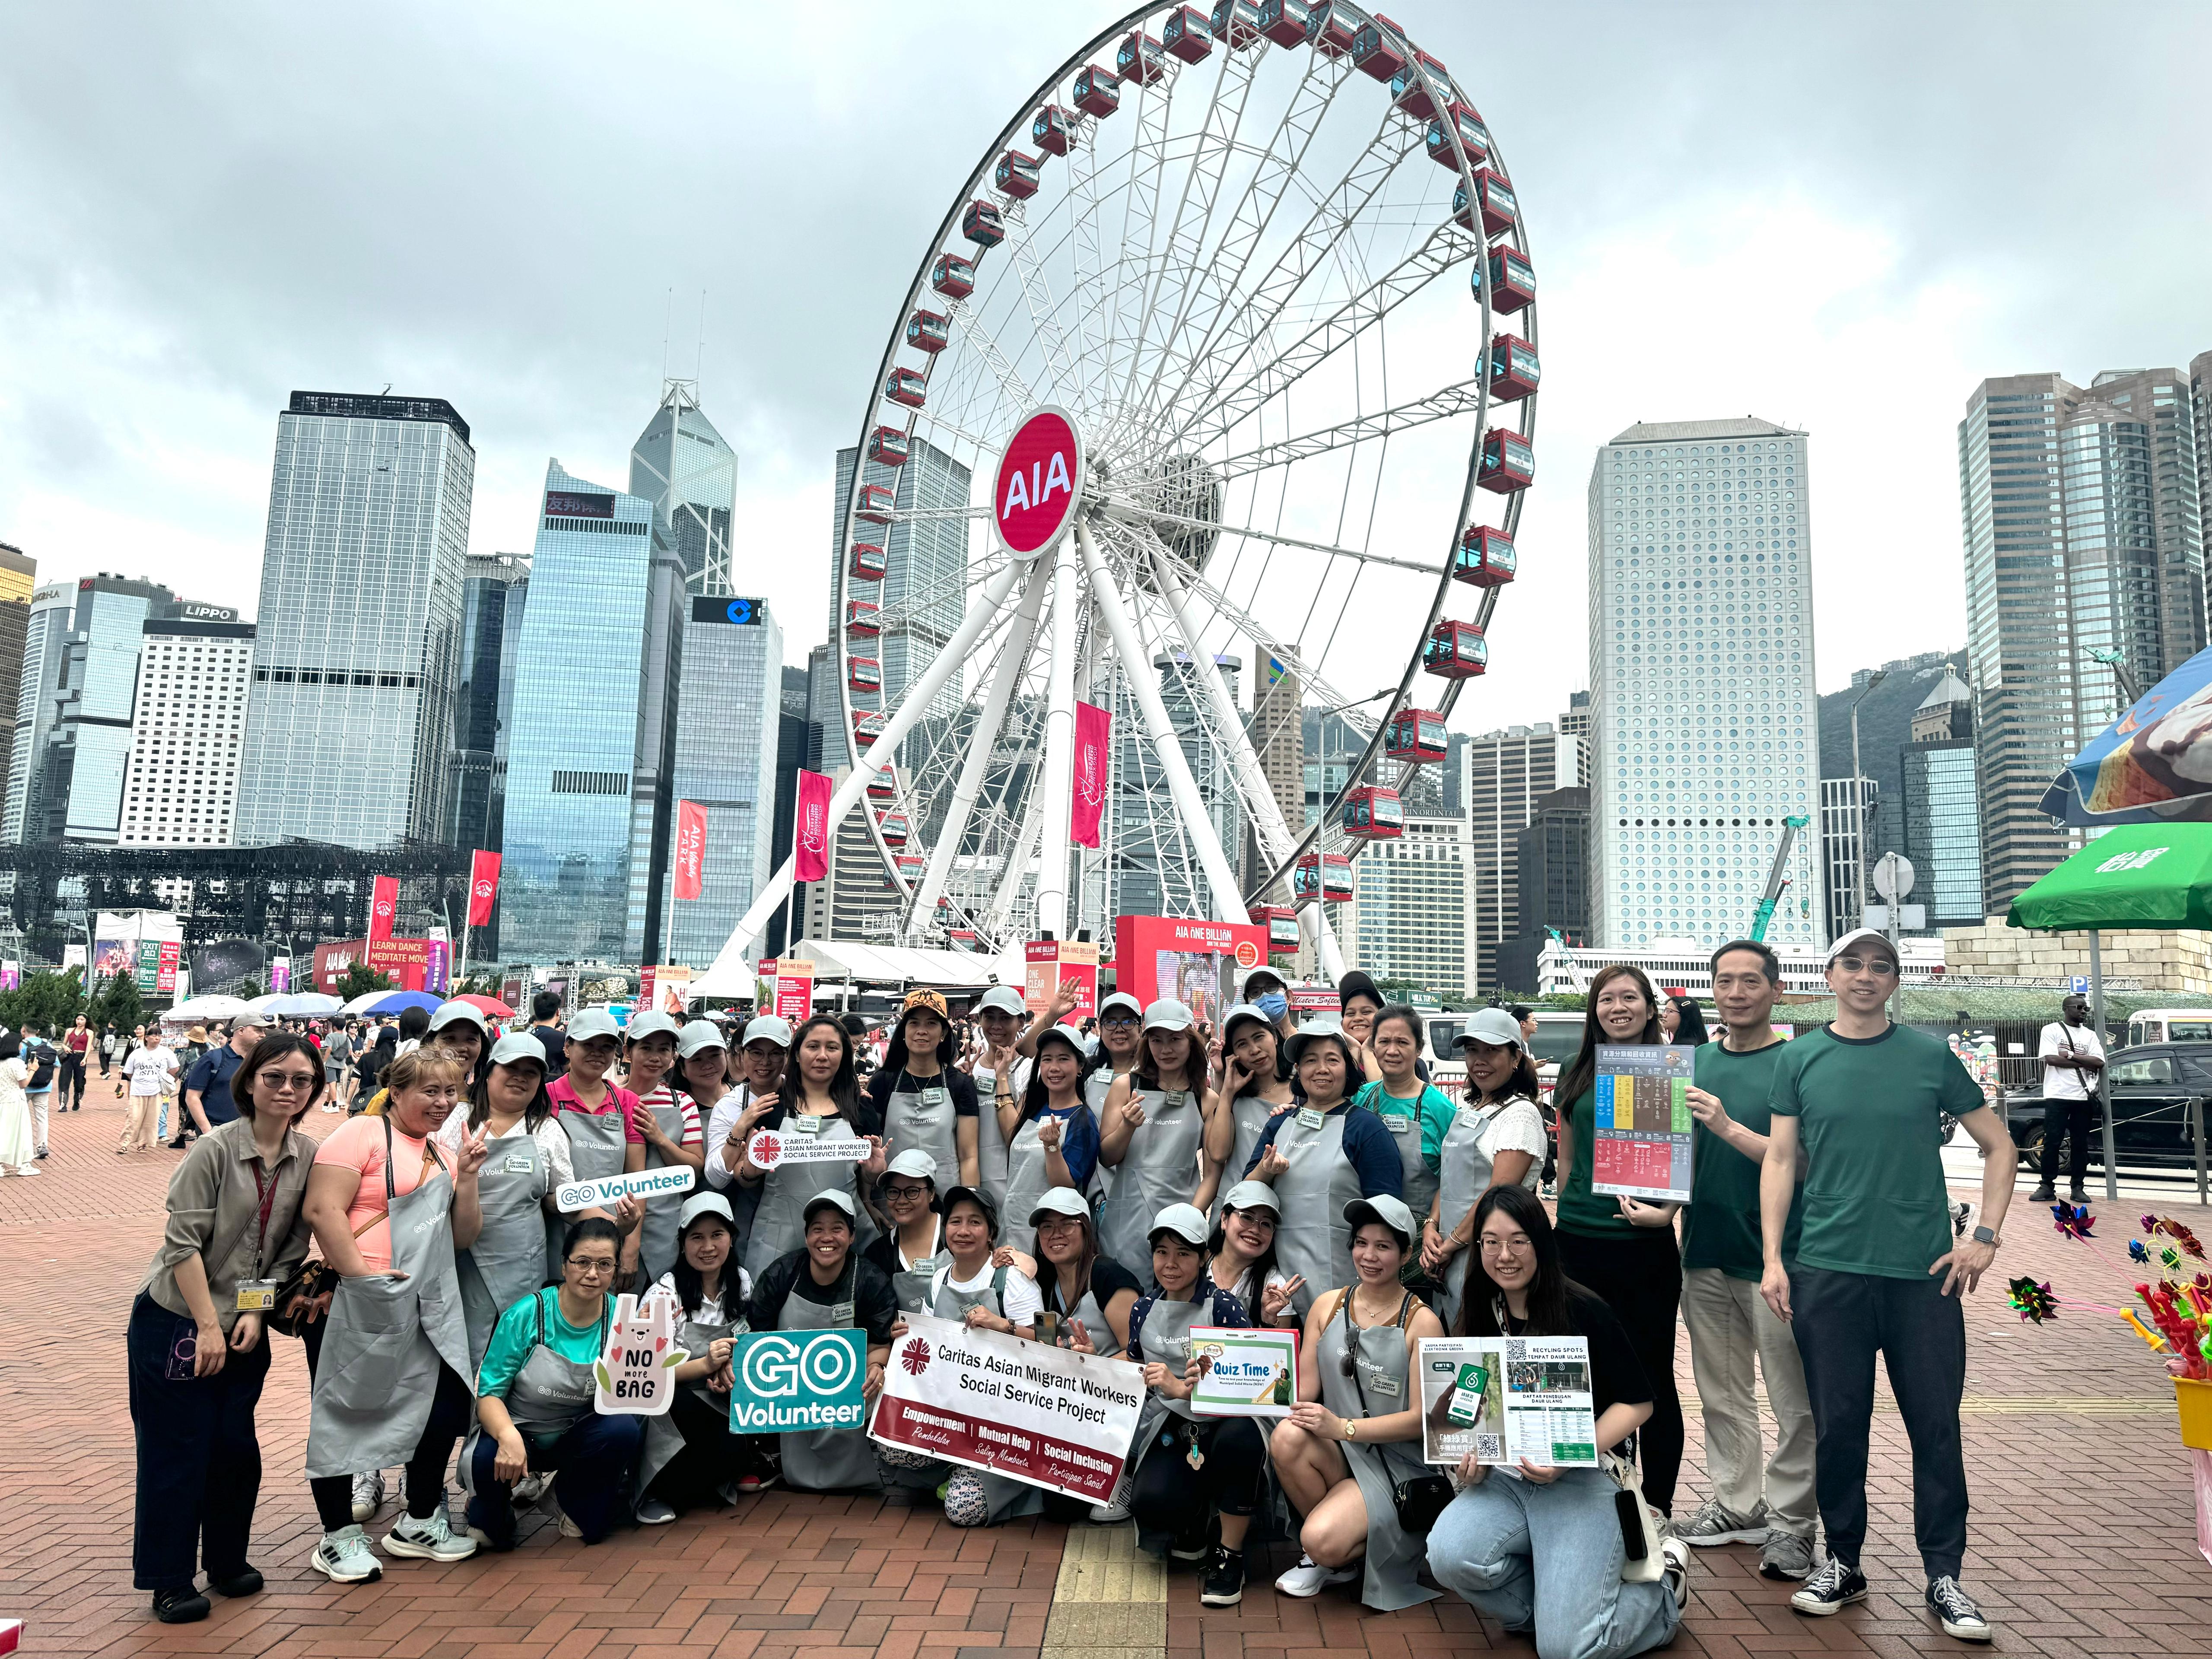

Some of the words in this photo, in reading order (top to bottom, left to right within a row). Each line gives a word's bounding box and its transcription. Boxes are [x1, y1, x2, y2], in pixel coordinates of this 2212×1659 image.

[1002, 451, 1071, 520] AIA
[186, 606, 230, 620] LIPPO
[690, 824, 700, 849] AIA
[1176, 926, 1189, 938] AIA
[1190, 927, 1205, 940] ONE
[1206, 928, 1232, 941] BILLION
[372, 941, 396, 950] LEARN
[399, 942, 423, 952] DANCE
[325, 952, 338, 971] AIA
[371, 952, 406, 962] MEDITATE
[408, 954, 429, 963] MOVE
[1028, 969, 1039, 979] ONE
[1028, 979, 1044, 988] CLEAR
[2073, 977, 2085, 991] P
[1028, 989, 1041, 998] GOAL
[912, 1116, 941, 1125] Volunteer
[1242, 1121, 1252, 1129] GO
[589, 1141, 620, 1150] Volunteer
[561, 1186, 595, 1205] GO
[598, 1173, 690, 1198] Volunteer
[413, 1223, 426, 1233] GO
[426, 1210, 446, 1225] Volunt
[909, 1298, 921, 1306] GO
[626, 1349, 652, 1367] NO
[742, 1334, 856, 1398] GO
[938, 1344, 981, 1368] Caritas
[984, 1356, 1023, 1377] Asian
[1026, 1365, 1077, 1392] Migrant
[1081, 1378, 1138, 1408] Workers
[1214, 1362, 1239, 1375] Quiz
[1242, 1363, 1270, 1376] Time
[538, 1386, 552, 1395] GO
[553, 1390, 589, 1402] Volunteer
[616, 1380, 655, 1398] BAG
[959, 1374, 1000, 1397] Social
[1004, 1383, 1053, 1410] Service
[1057, 1397, 1106, 1424] Project
[734, 1402, 861, 1427] Volunteer
[902, 1406, 966, 1433] Empowerment
[912, 1427, 950, 1446] Pembekalan
[978, 1425, 1011, 1445] Mutual
[1011, 1434, 1031, 1452] Help
[1440, 1433, 1473, 1444] 「綠綠賞」
[975, 1444, 995, 1462] Saling
[997, 1449, 1029, 1468] Membantu
[1044, 1443, 1072, 1463] Social
[1073, 1453, 1113, 1476] Inclusion
[1048, 1463, 1083, 1484] Partisipasi
